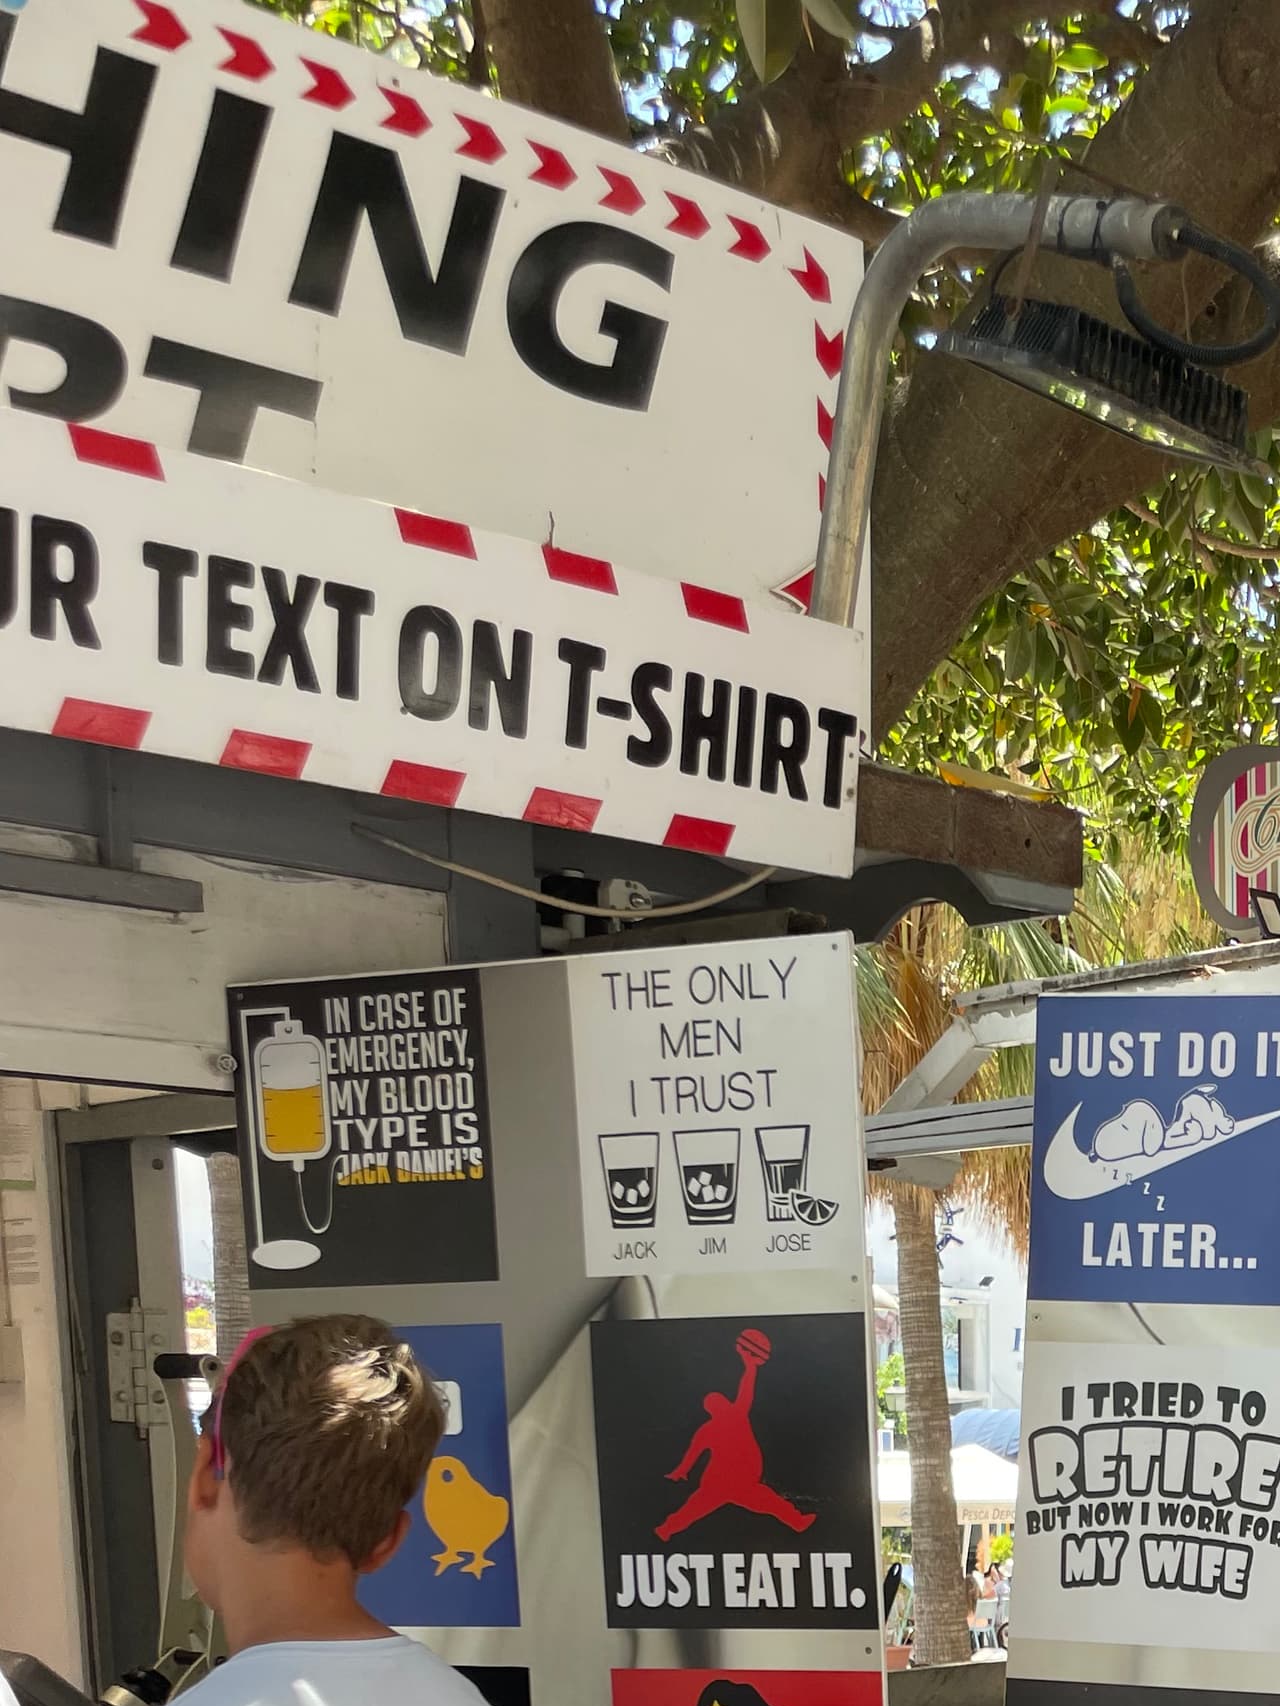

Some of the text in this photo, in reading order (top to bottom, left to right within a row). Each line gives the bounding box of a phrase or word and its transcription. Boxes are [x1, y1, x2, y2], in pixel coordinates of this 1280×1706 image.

[142, 541, 375, 701] TEXT
[398, 605, 533, 739] ON
[558, 638, 858, 808] T-SHIRT
[601, 956, 797, 1011] THE ONLY
[324, 988, 467, 1034] IN CASE OF
[326, 1028, 474, 1076] EMERGENCY,
[660, 1017, 742, 1060] MEN
[1050, 1031, 1162, 1078] JUST
[1177, 1031, 1236, 1078] DO
[329, 1072, 474, 1117] MY BLOOD
[333, 1112, 479, 1151] TYPE IS
[614, 1241, 657, 1260] JACK
[699, 1237, 727, 1255] JIM
[766, 1233, 811, 1252] JOSE
[616, 1552, 867, 1608] JUST EAT IT.
[1061, 1530, 1253, 1601] MY WIFE
